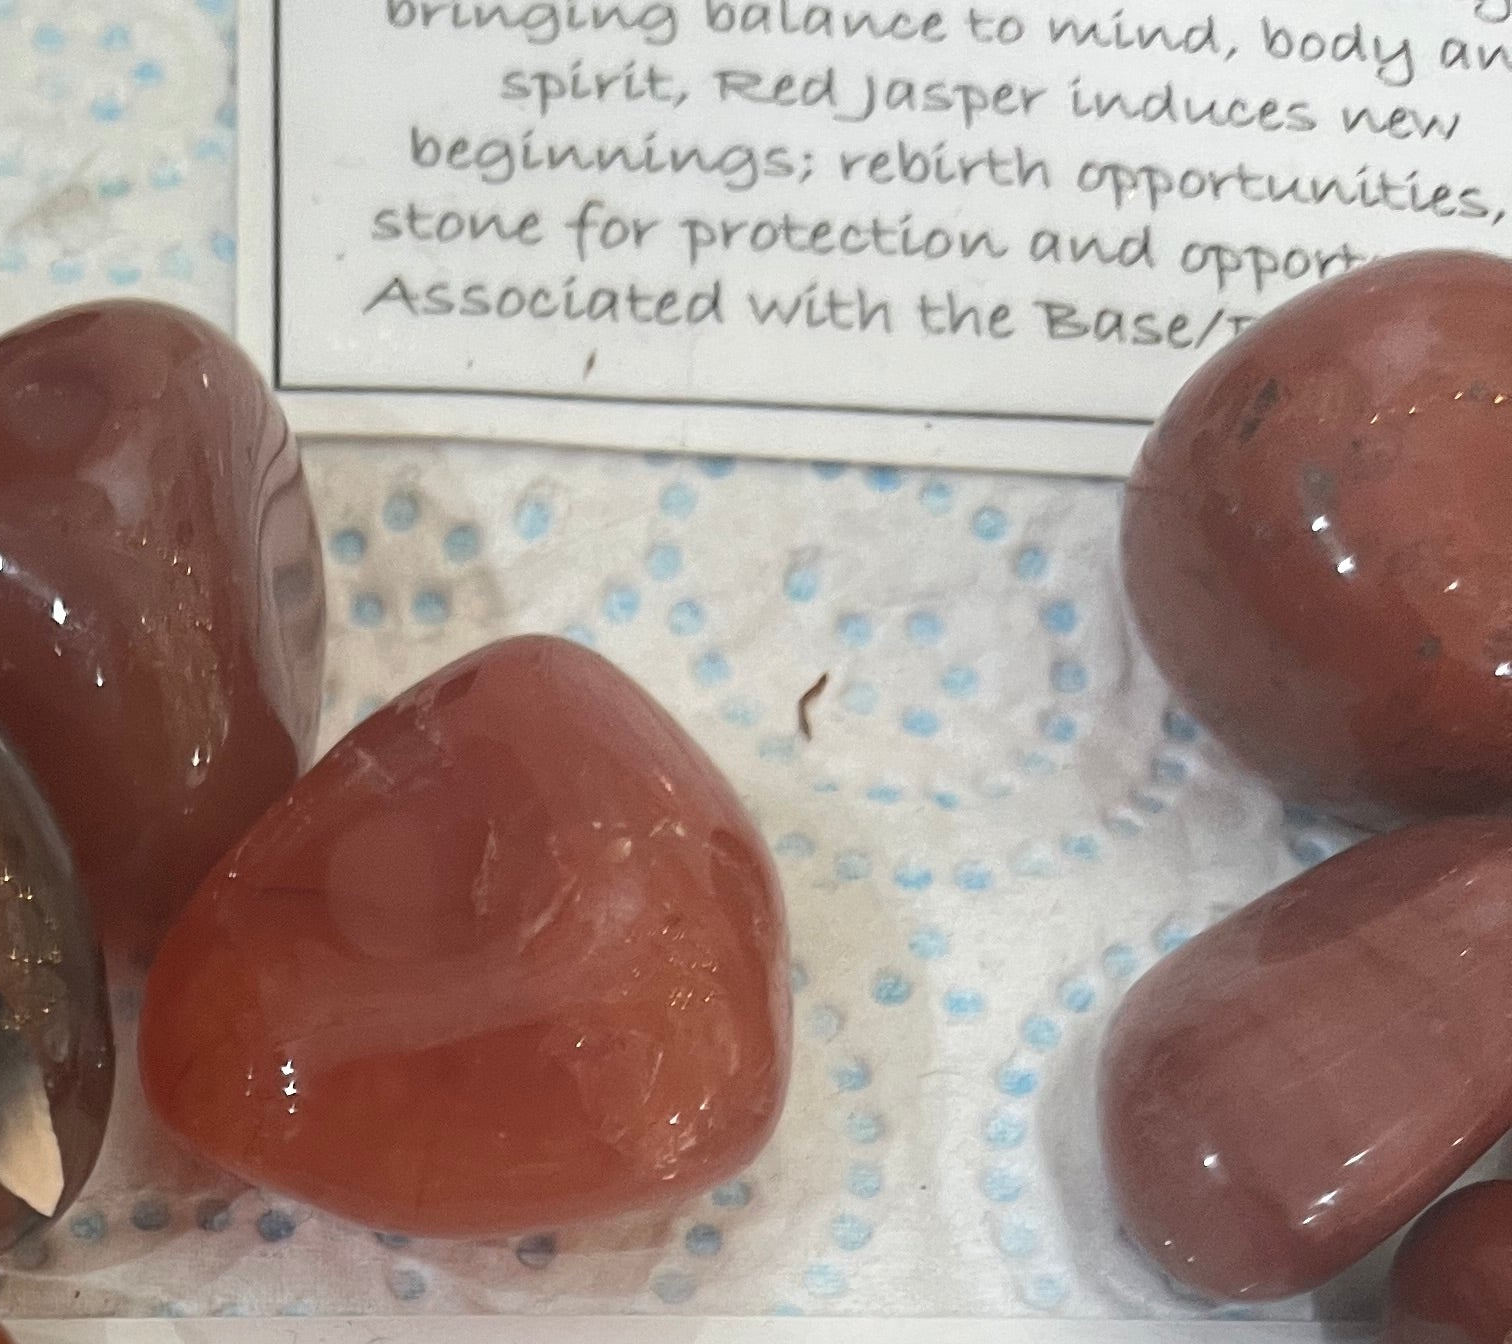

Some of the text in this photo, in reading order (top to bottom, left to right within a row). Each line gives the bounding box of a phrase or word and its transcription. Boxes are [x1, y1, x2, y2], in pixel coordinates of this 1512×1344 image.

[386, 0, 678, 45] bringing
[706, 0, 947, 42] balance
[965, 8, 1025, 44] to
[1048, 9, 1238, 61] mind,
[1261, 16, 1414, 87] body
[501, 60, 688, 115] spirit,
[713, 67, 837, 106] Red
[1071, 77, 1317, 131] induces
[1342, 107, 1461, 141] new
[410, 125, 1505, 225] beginnings; rebirth opportunities,
[372, 199, 1375, 292] stone for protection and opport
[362, 276, 724, 325] Associated
[748, 283, 892, 333] with
[917, 292, 1014, 339] the
